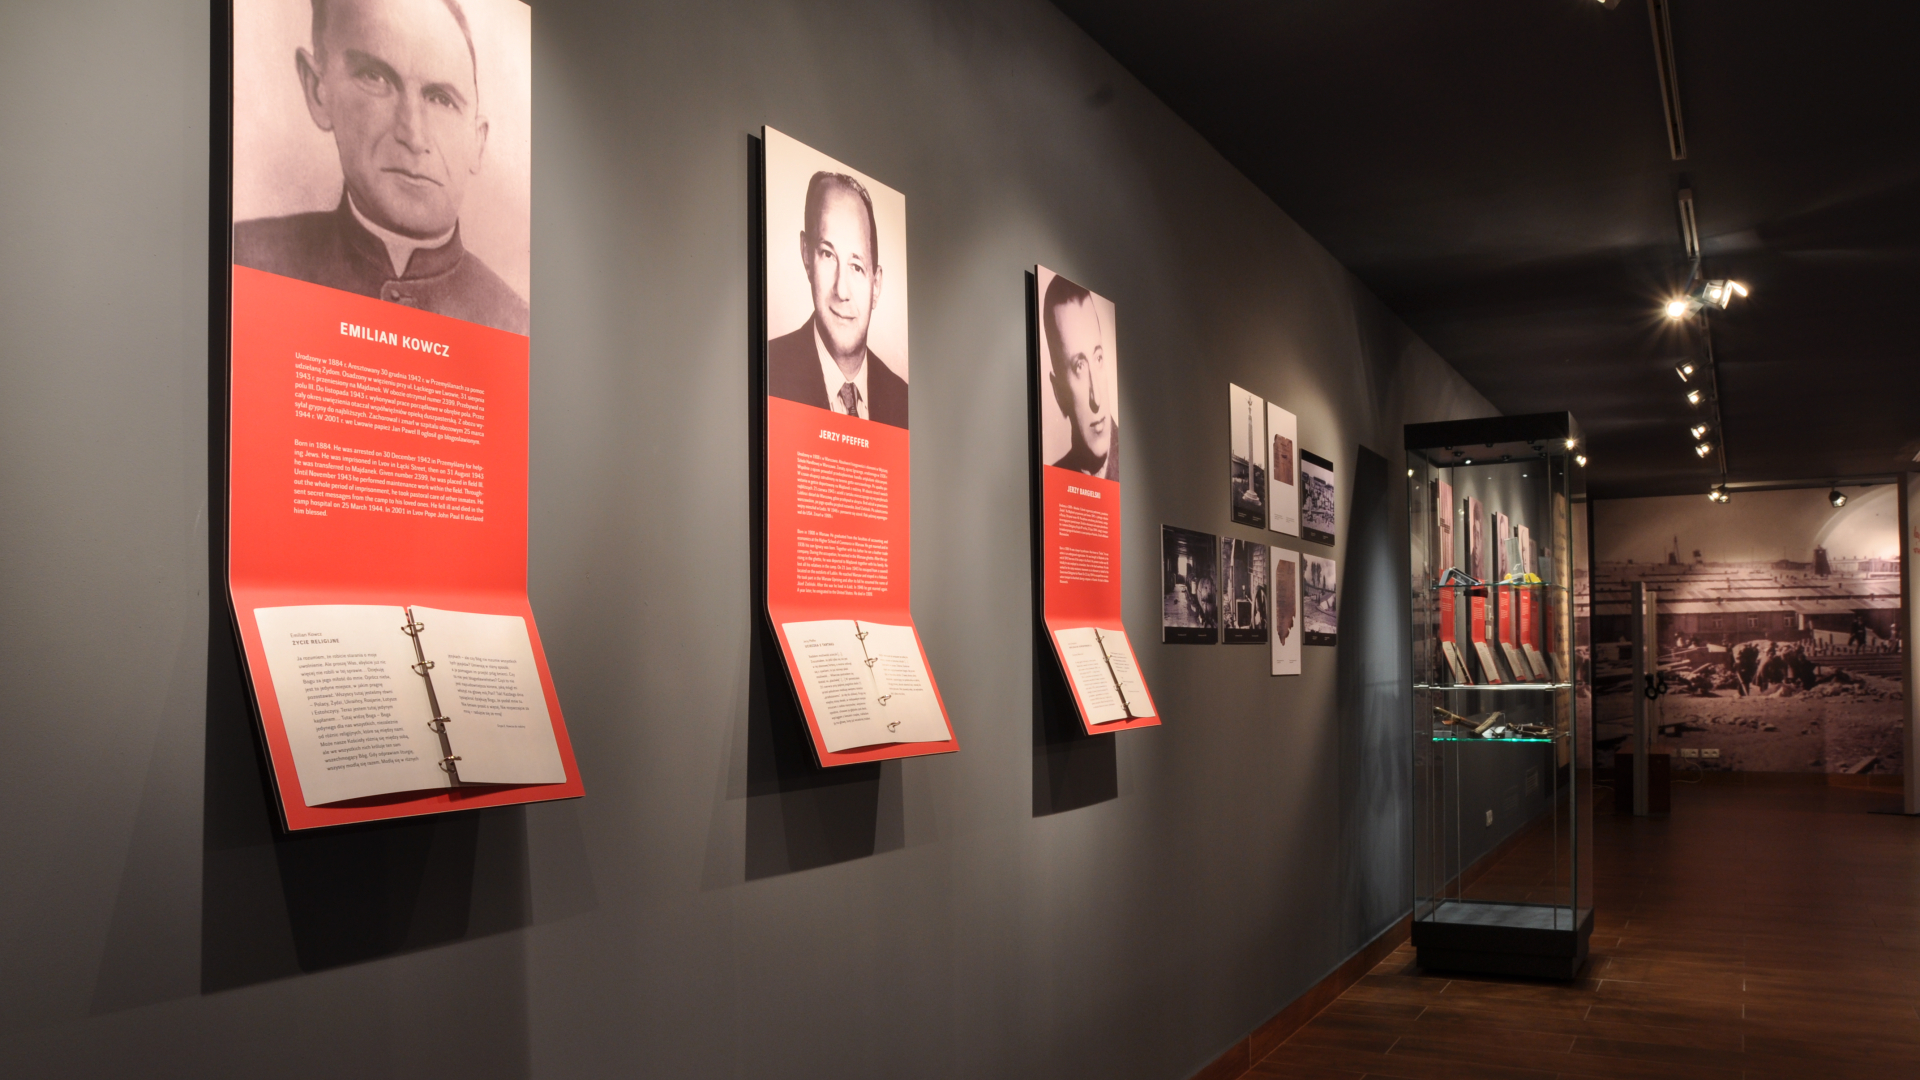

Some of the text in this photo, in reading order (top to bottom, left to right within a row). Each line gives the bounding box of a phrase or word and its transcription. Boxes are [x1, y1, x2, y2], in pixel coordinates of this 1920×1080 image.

[340, 321, 450, 357] EMILIAN KOWCZ
[295, 352, 322, 364] Urodzony
[328, 358, 343, 367] 1884
[348, 362, 380, 376] Aresztowany
[381, 368, 389, 376] 30
[408, 374, 421, 382] 1942
[296, 371, 311, 380] 1943
[316, 384, 325, 392] Do
[324, 386, 349, 396] listopada
[350, 390, 365, 399] 1943
[295, 410, 311, 418] 1944
[324, 414, 339, 423] 2001
[819, 429, 869, 449] JERZY PFEFFER
[294, 438, 308, 447] Born
[333, 444, 342, 452] He
[353, 448, 375, 456] arrested
[391, 452, 416, 461] December
[417, 456, 431, 464] 1942
[294, 450, 304, 458] ing
[342, 456, 371, 465] imprisoned
[454, 470, 471, 479] August
[472, 472, 484, 480] 1943
[294, 458, 302, 466] he
[314, 462, 344, 471] transferred
[378, 468, 394, 477] Given
[294, 468, 308, 476] Until
[308, 469, 336, 479] November
[337, 473, 352, 481] 1943
[359, 476, 386, 485] performed
[386, 480, 418, 489] maintenance
[314, 480, 331, 488] whole
[1067, 485, 1079, 494] JERZY
[325, 492, 351, 501] messages
[352, 493, 364, 501] from
[374, 497, 389, 505] camp
[403, 499, 417, 507] loved
[305, 508, 327, 516] blessed.
[310, 499, 332, 508] hospital
[341, 501, 350, 509] 25
[350, 502, 367, 510] March
[391, 506, 405, 514] 2001
[424, 510, 437, 518] Pope
[449, 512, 460, 520] Paul
